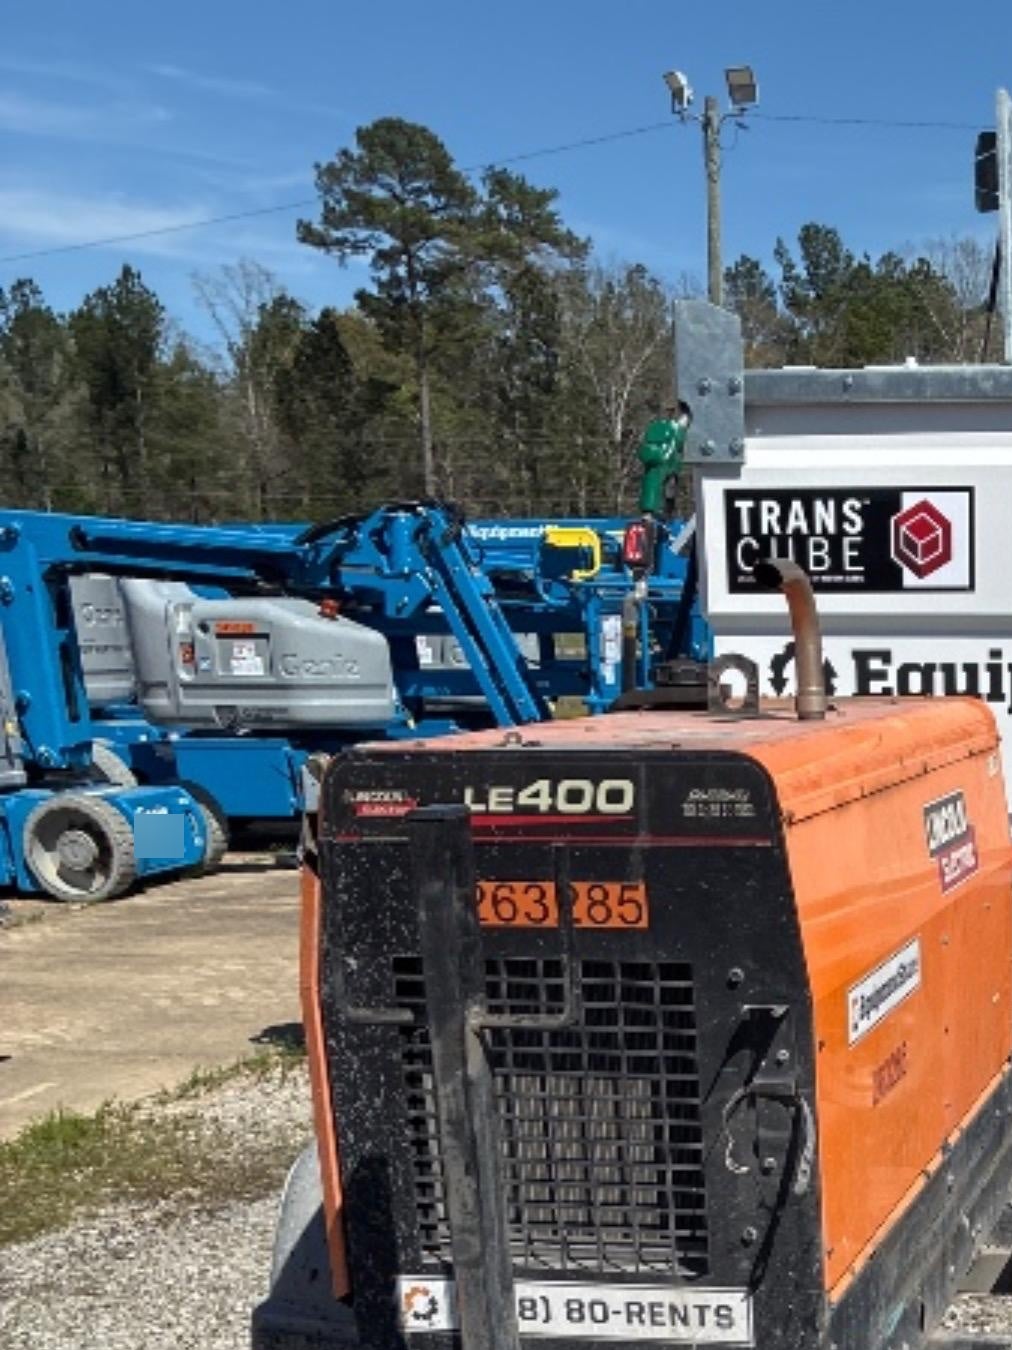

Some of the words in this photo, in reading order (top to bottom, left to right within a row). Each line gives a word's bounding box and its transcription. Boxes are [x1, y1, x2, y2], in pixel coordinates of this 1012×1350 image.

[734, 499, 864, 535] TRANS
[737, 536, 864, 572] CUBE
[464, 779, 635, 815] LE400
[566, 1299, 735, 1330] 80-RENTS
